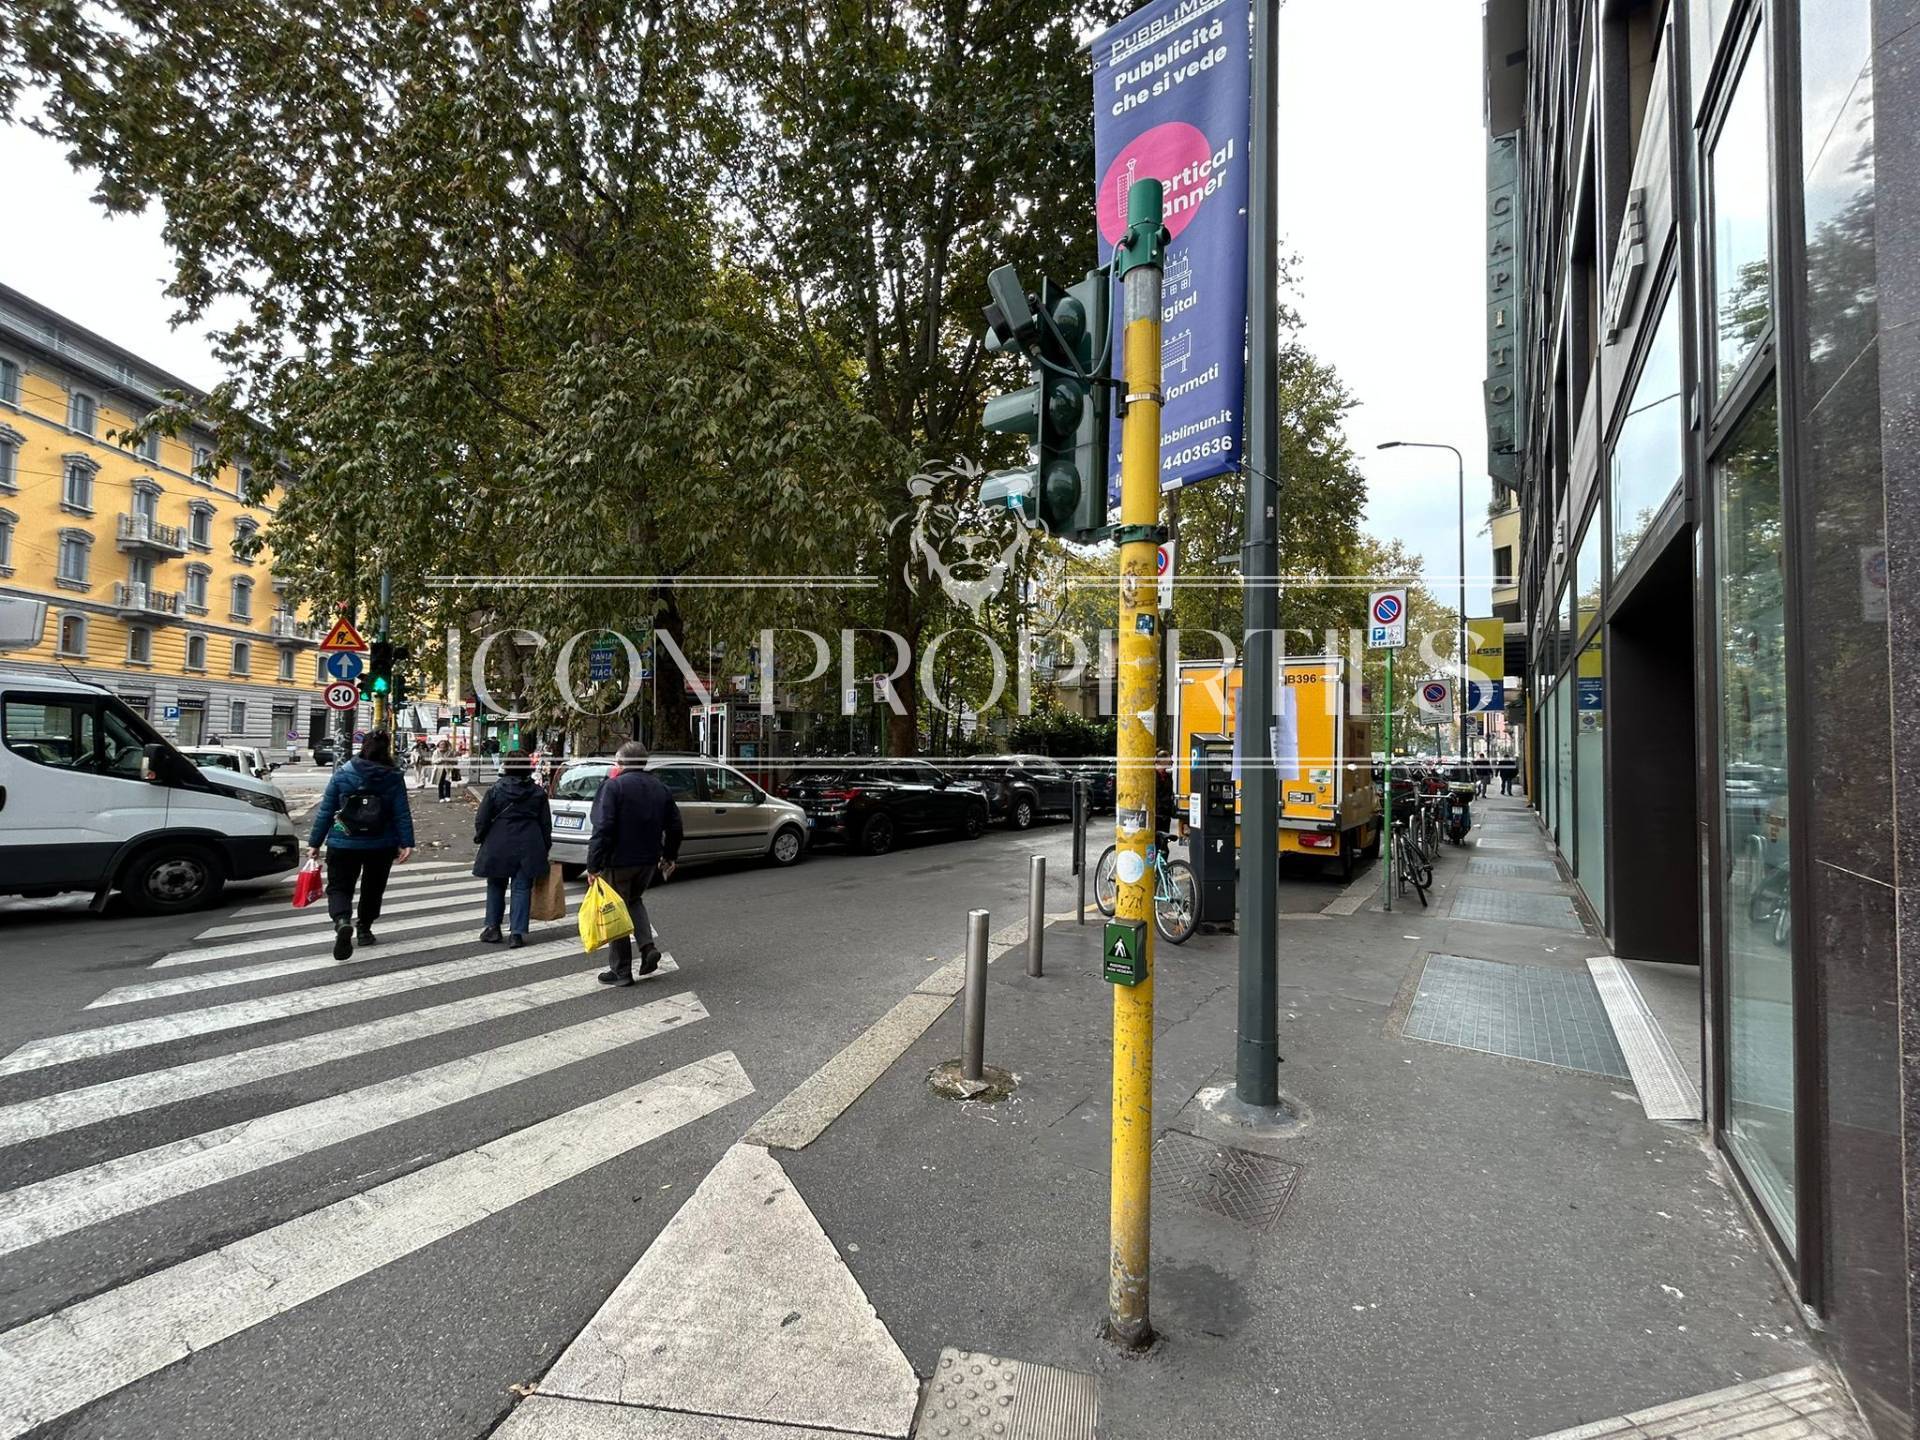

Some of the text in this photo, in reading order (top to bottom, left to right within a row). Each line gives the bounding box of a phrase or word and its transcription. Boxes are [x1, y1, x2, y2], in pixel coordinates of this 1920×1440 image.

[1114, 18, 1224, 92] Pubblicità
[1112, 46, 1228, 117] che si vede
[1162, 138, 1234, 195] ertical
[1162, 169, 1227, 219] anner
[1161, 290, 1197, 323] igital
[1489, 195, 1513, 447] CAPITOL
[1166, 362, 1220, 401] formati
[1162, 435, 1233, 471] 4403636
[1374, 628, 1385, 640] P
[166, 707, 177, 718] P
[331, 689, 352, 703] 30
